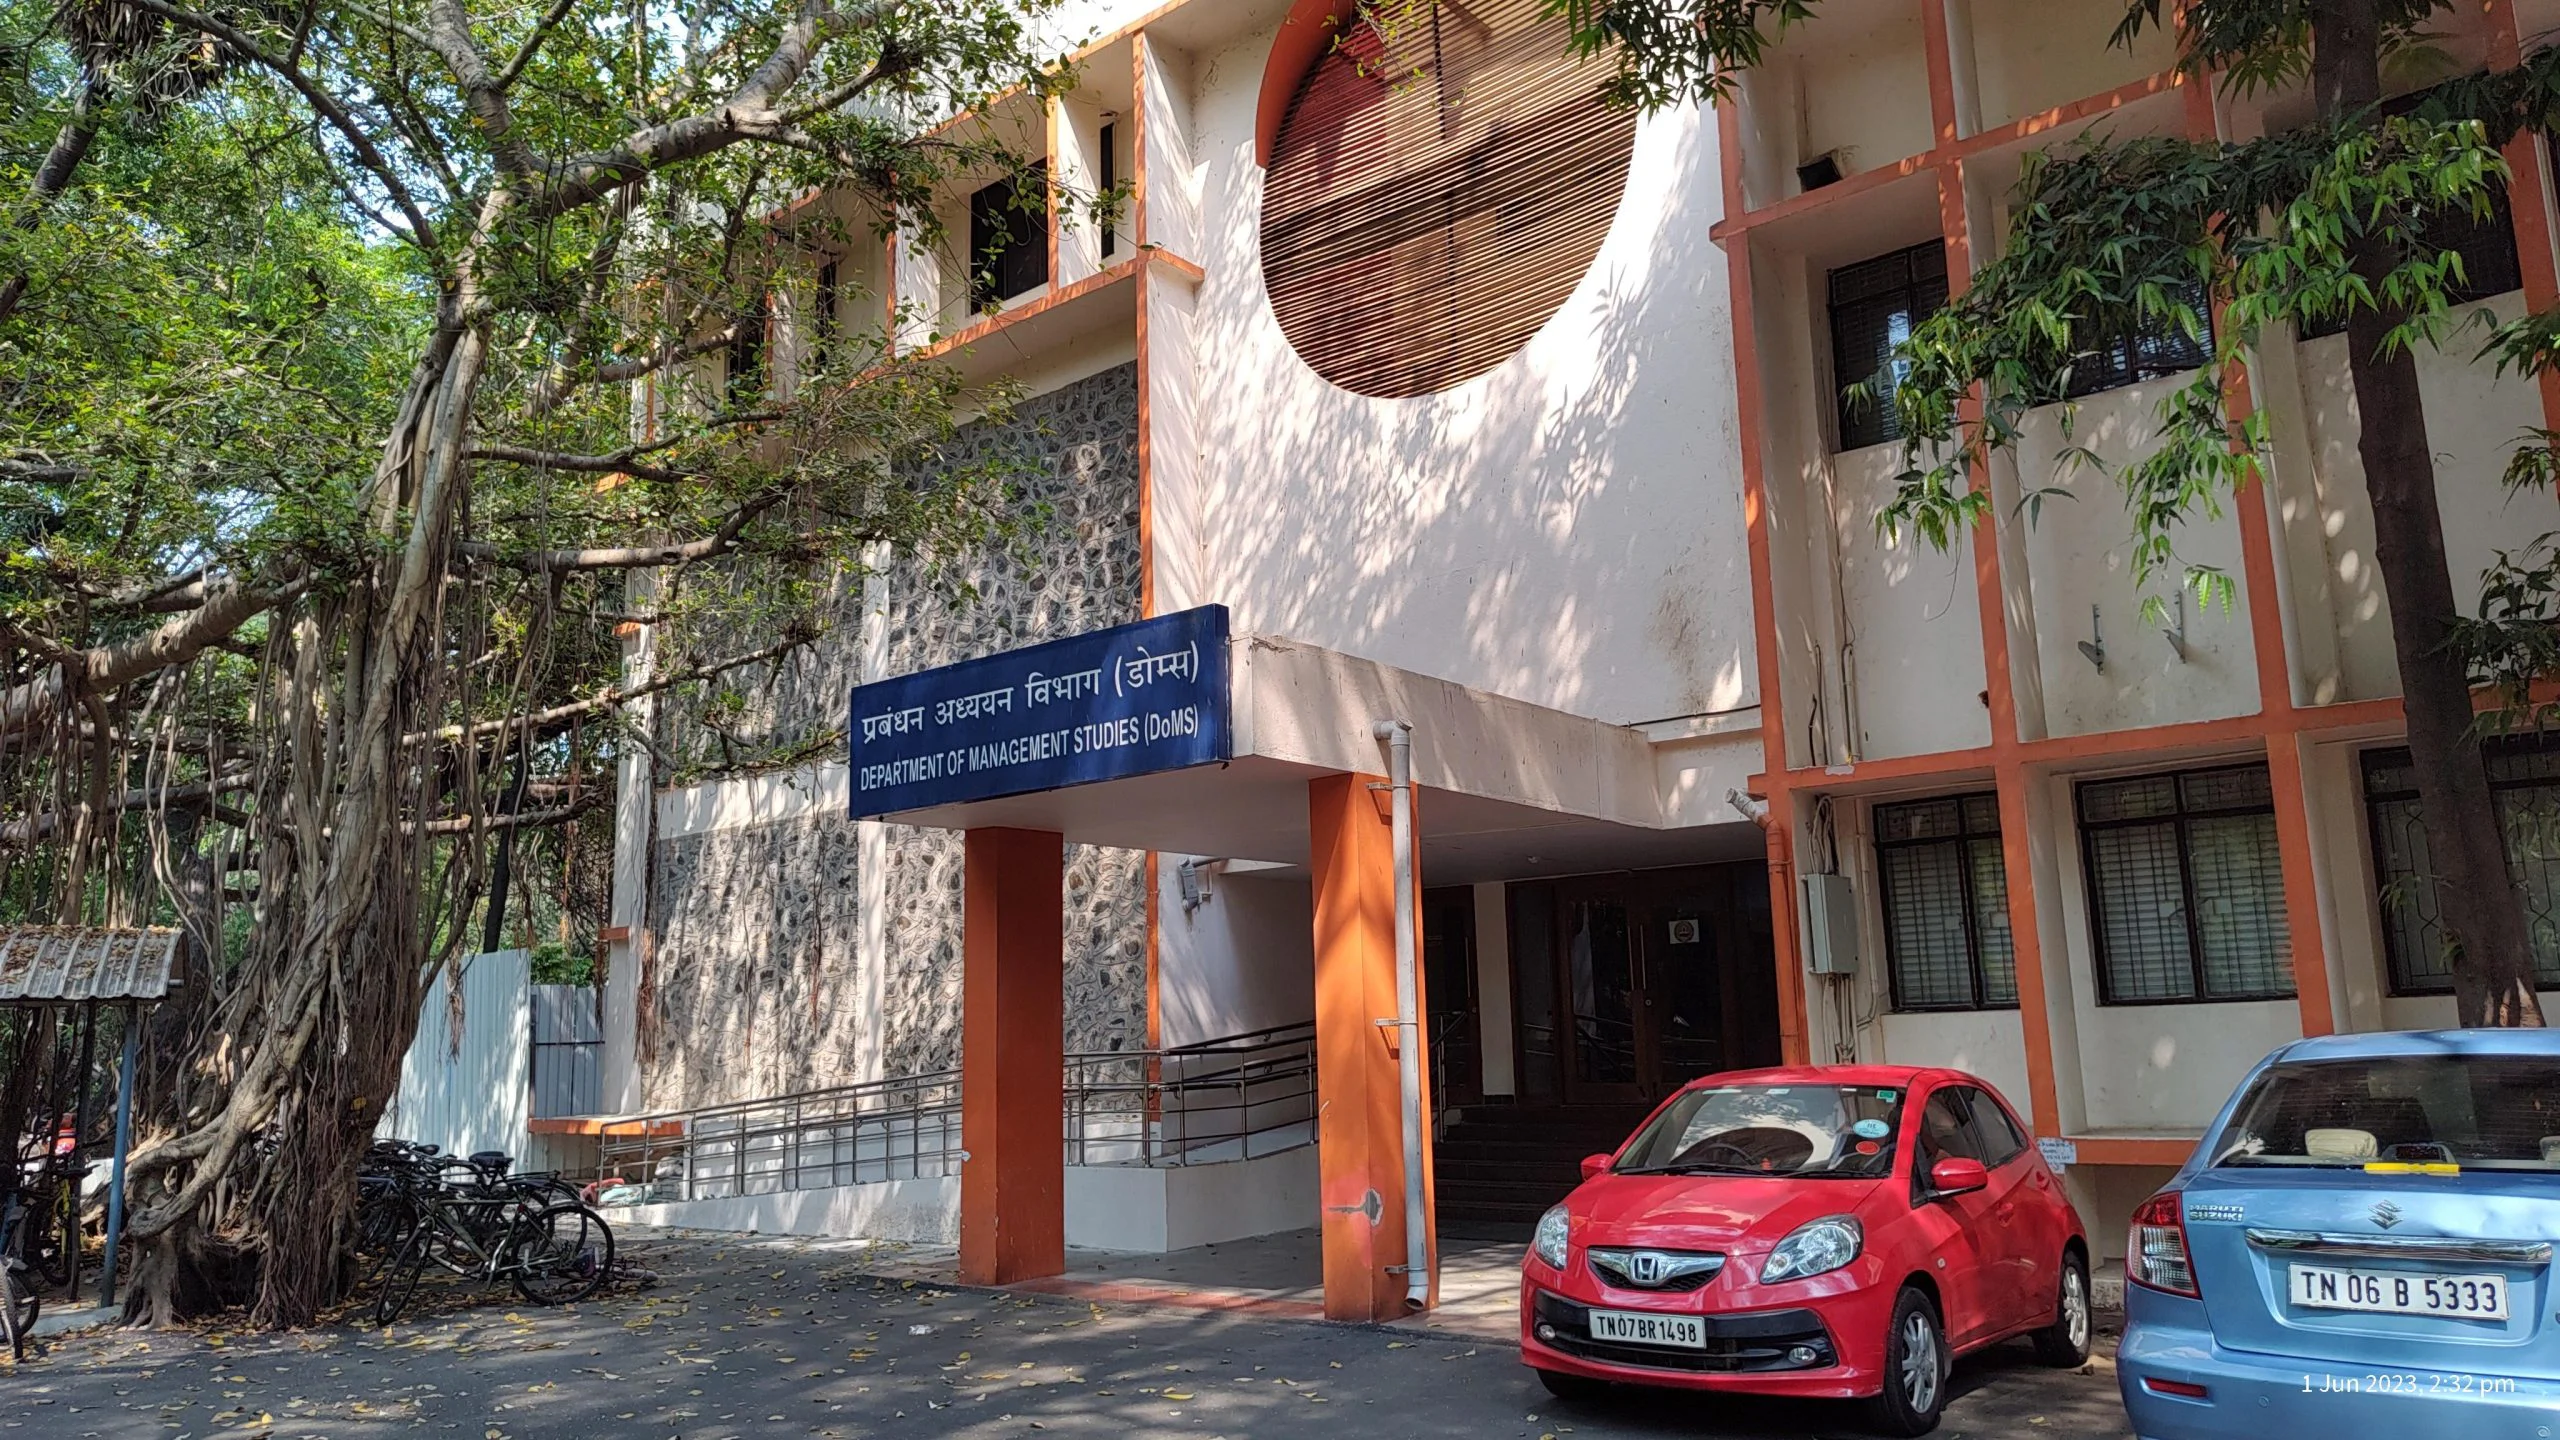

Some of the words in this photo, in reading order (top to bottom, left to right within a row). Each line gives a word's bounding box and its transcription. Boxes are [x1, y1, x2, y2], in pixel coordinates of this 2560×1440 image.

[862, 706, 925, 744] प्रबंधन
[934, 687, 1012, 725] अध्ययन
[1025, 671, 1101, 708] विभाग
[1114, 640, 1198, 697] (डोम्स)
[861, 753, 944, 790] DEPARTMENT
[947, 749, 966, 776] OF
[969, 729, 1069, 772] MANAGEMENT
[1073, 717, 1139, 753] STUDIES
[1144, 704, 1198, 746] (DoMS)
[2189, 1204, 2245, 1213] MARUTI
[2189, 1211, 2243, 1222] SUZUKI
[2301, 1271, 2337, 1301] TN
[2347, 1274, 2381, 1305] 06
[2394, 1278, 2409, 1307] B
[2424, 1279, 2497, 1312] 5333
